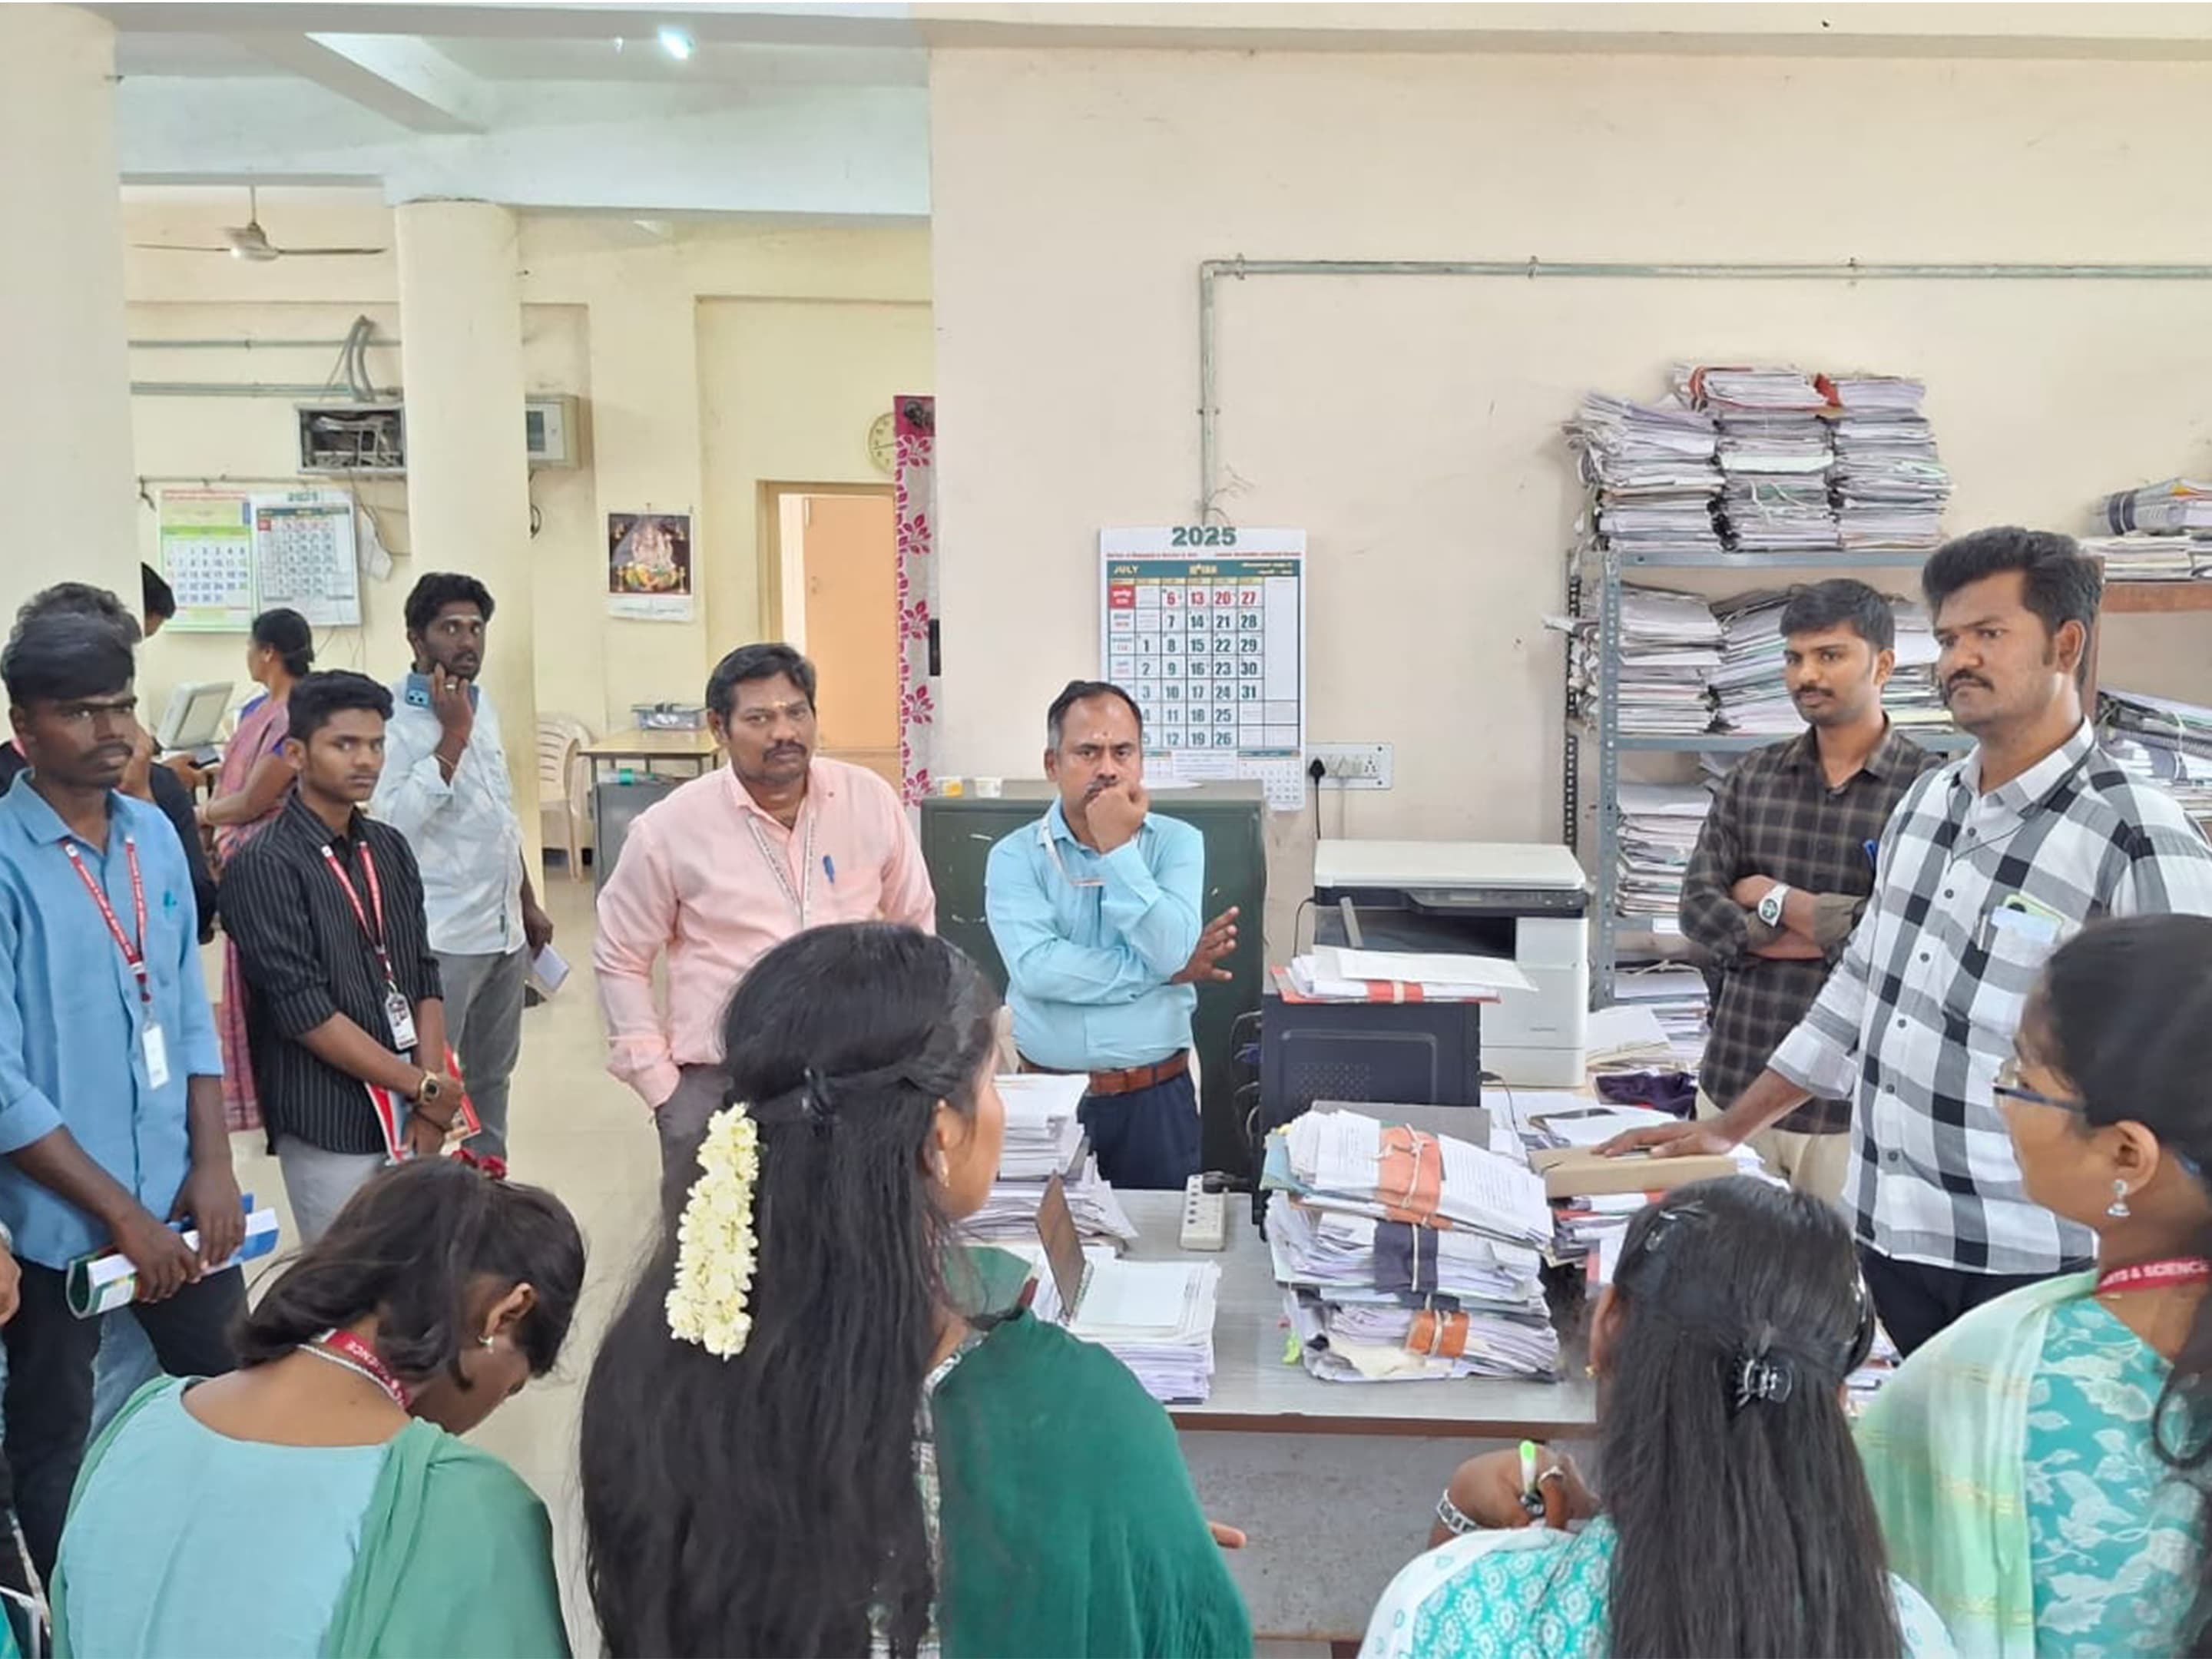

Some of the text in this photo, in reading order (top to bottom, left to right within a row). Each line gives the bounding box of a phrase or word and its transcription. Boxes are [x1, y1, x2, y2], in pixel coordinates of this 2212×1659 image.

[1172, 527, 1237, 546] 2025
[1114, 565, 1138, 575] JULY
[1190, 592, 1204, 605] 13
[1215, 592, 1231, 605] 20
[1242, 592, 1256, 605] 27
[1168, 615, 1257, 628] 7 14 21 28
[1144, 639, 1149, 652] 1
[1167, 639, 1175, 652] 8
[1190, 639, 1204, 652] 15
[1215, 639, 1230, 652] 22
[1241, 639, 1257, 652] 29
[1143, 663, 1151, 676] 2
[1167, 663, 1176, 676] 9
[1190, 663, 1204, 676] 16
[1215, 663, 1231, 676] 23
[1241, 663, 1257, 676] 30
[1142, 686, 1256, 699] 3 10 17 24 31
[1167, 709, 1178, 722] 11
[1191, 709, 1205, 722] 18
[1216, 709, 1231, 722] 25
[1166, 733, 1179, 746] 12
[1191, 733, 1205, 746] 19
[1216, 733, 1231, 746] 26
